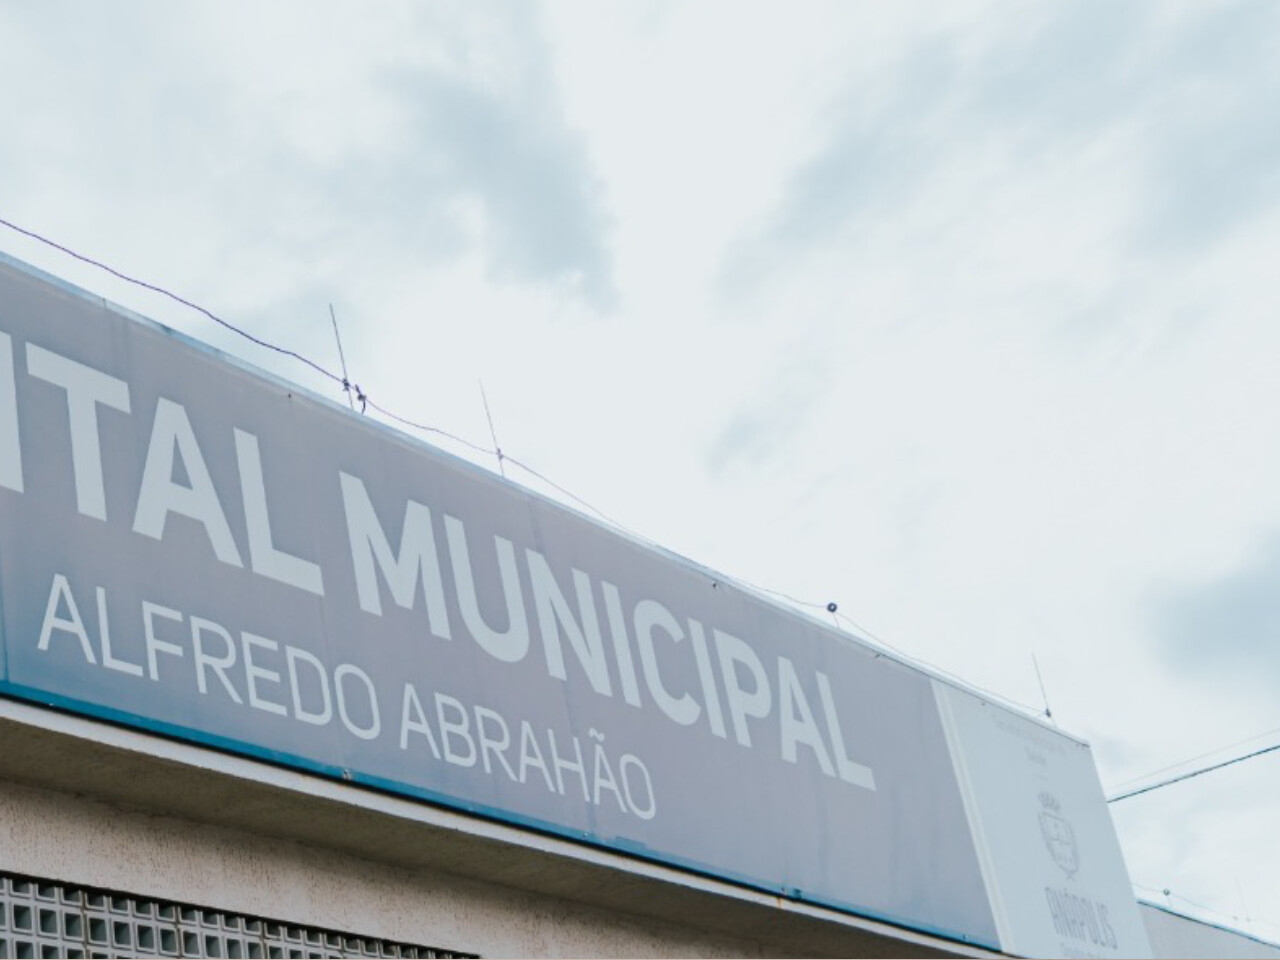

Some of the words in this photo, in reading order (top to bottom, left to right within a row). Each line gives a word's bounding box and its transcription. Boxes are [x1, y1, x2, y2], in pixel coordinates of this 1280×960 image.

[37, 573, 381, 740] ALFREDO
[399, 682, 657, 821] ABRAHÃO
[338, 470, 877, 791] MUNICIPAL
